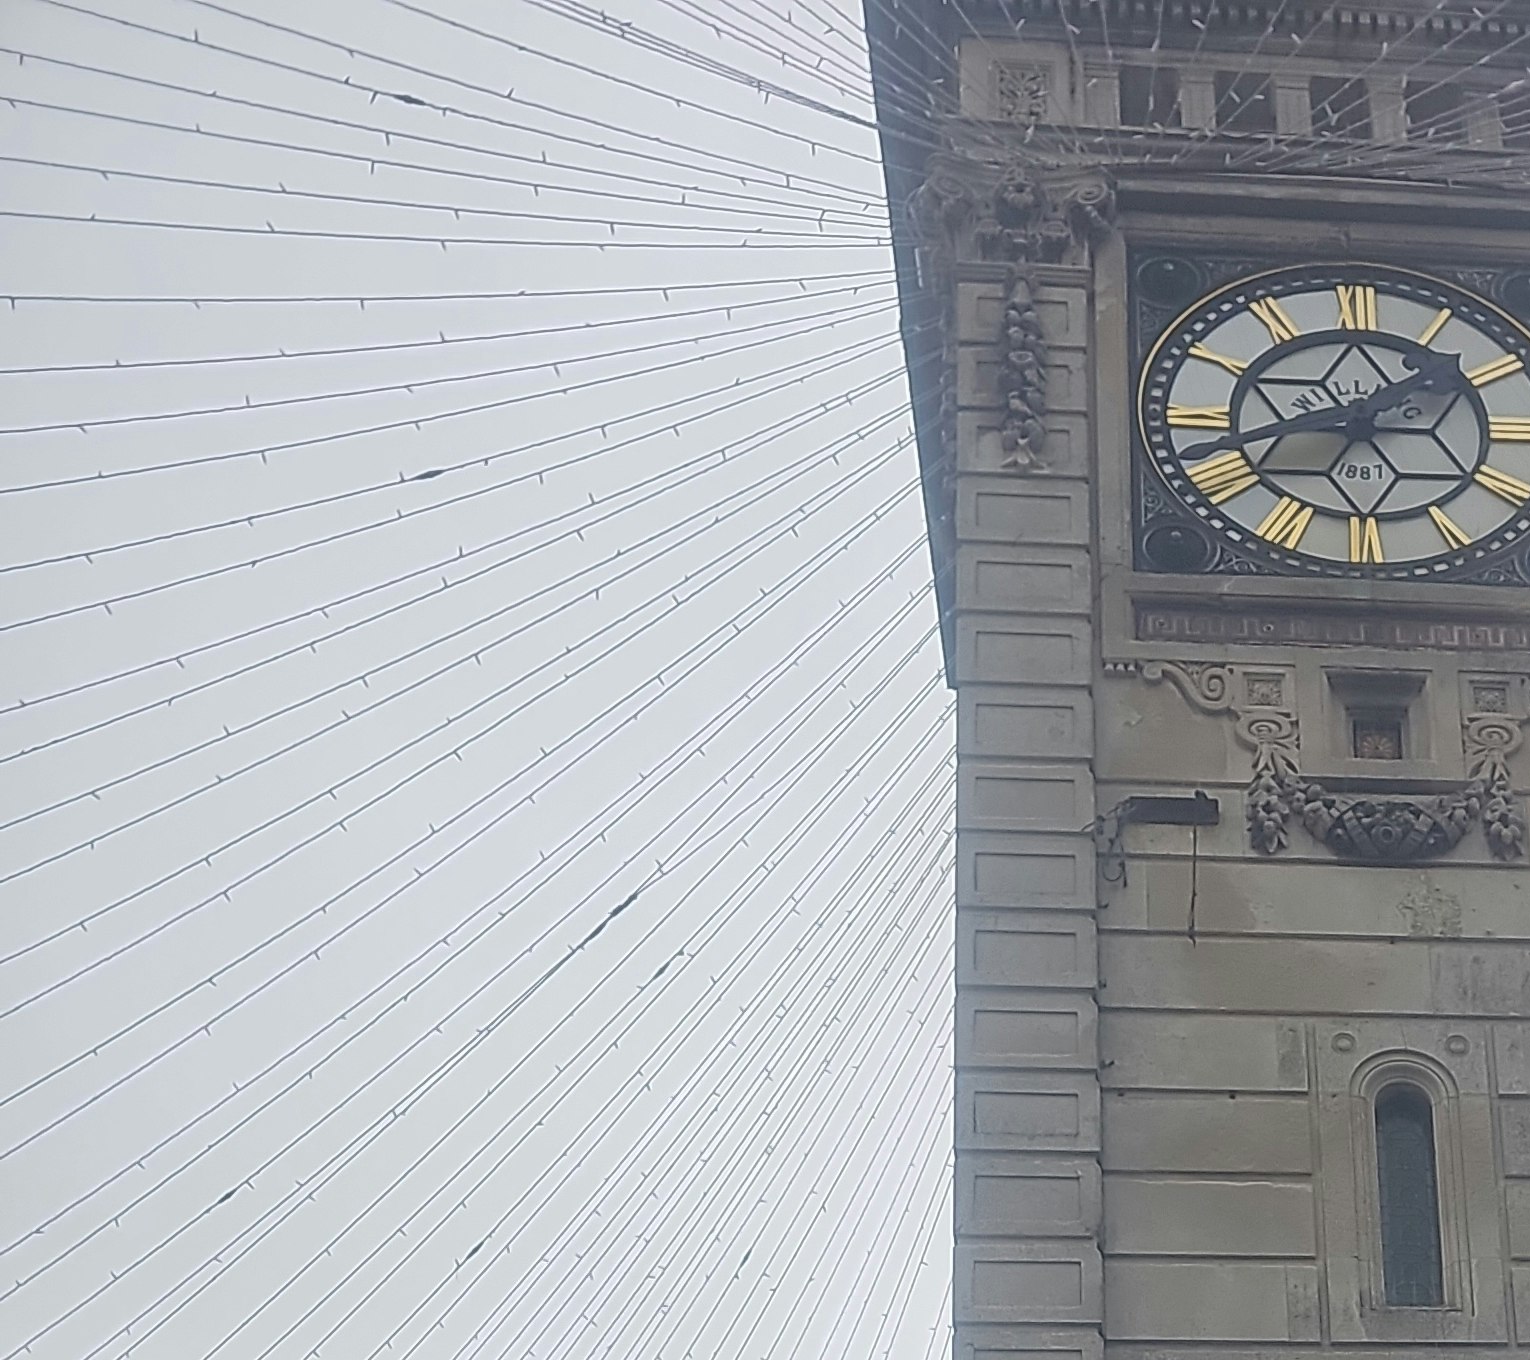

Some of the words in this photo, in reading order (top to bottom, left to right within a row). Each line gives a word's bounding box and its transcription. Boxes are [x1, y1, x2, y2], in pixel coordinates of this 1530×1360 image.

[1248, 296, 1302, 345] XI
[1336, 285, 1377, 332] XII
[1418, 307, 1453, 347] I
[1187, 341, 1250, 377] X
[1465, 352, 1525, 387] II
[1165, 402, 1231, 429] IX
[1184, 449, 1262, 506] VIII
[1336, 461, 1384, 481] 1887
[1254, 495, 1316, 551] VII
[1349, 516, 1385, 564] VI
[1427, 505, 1473, 551] V
